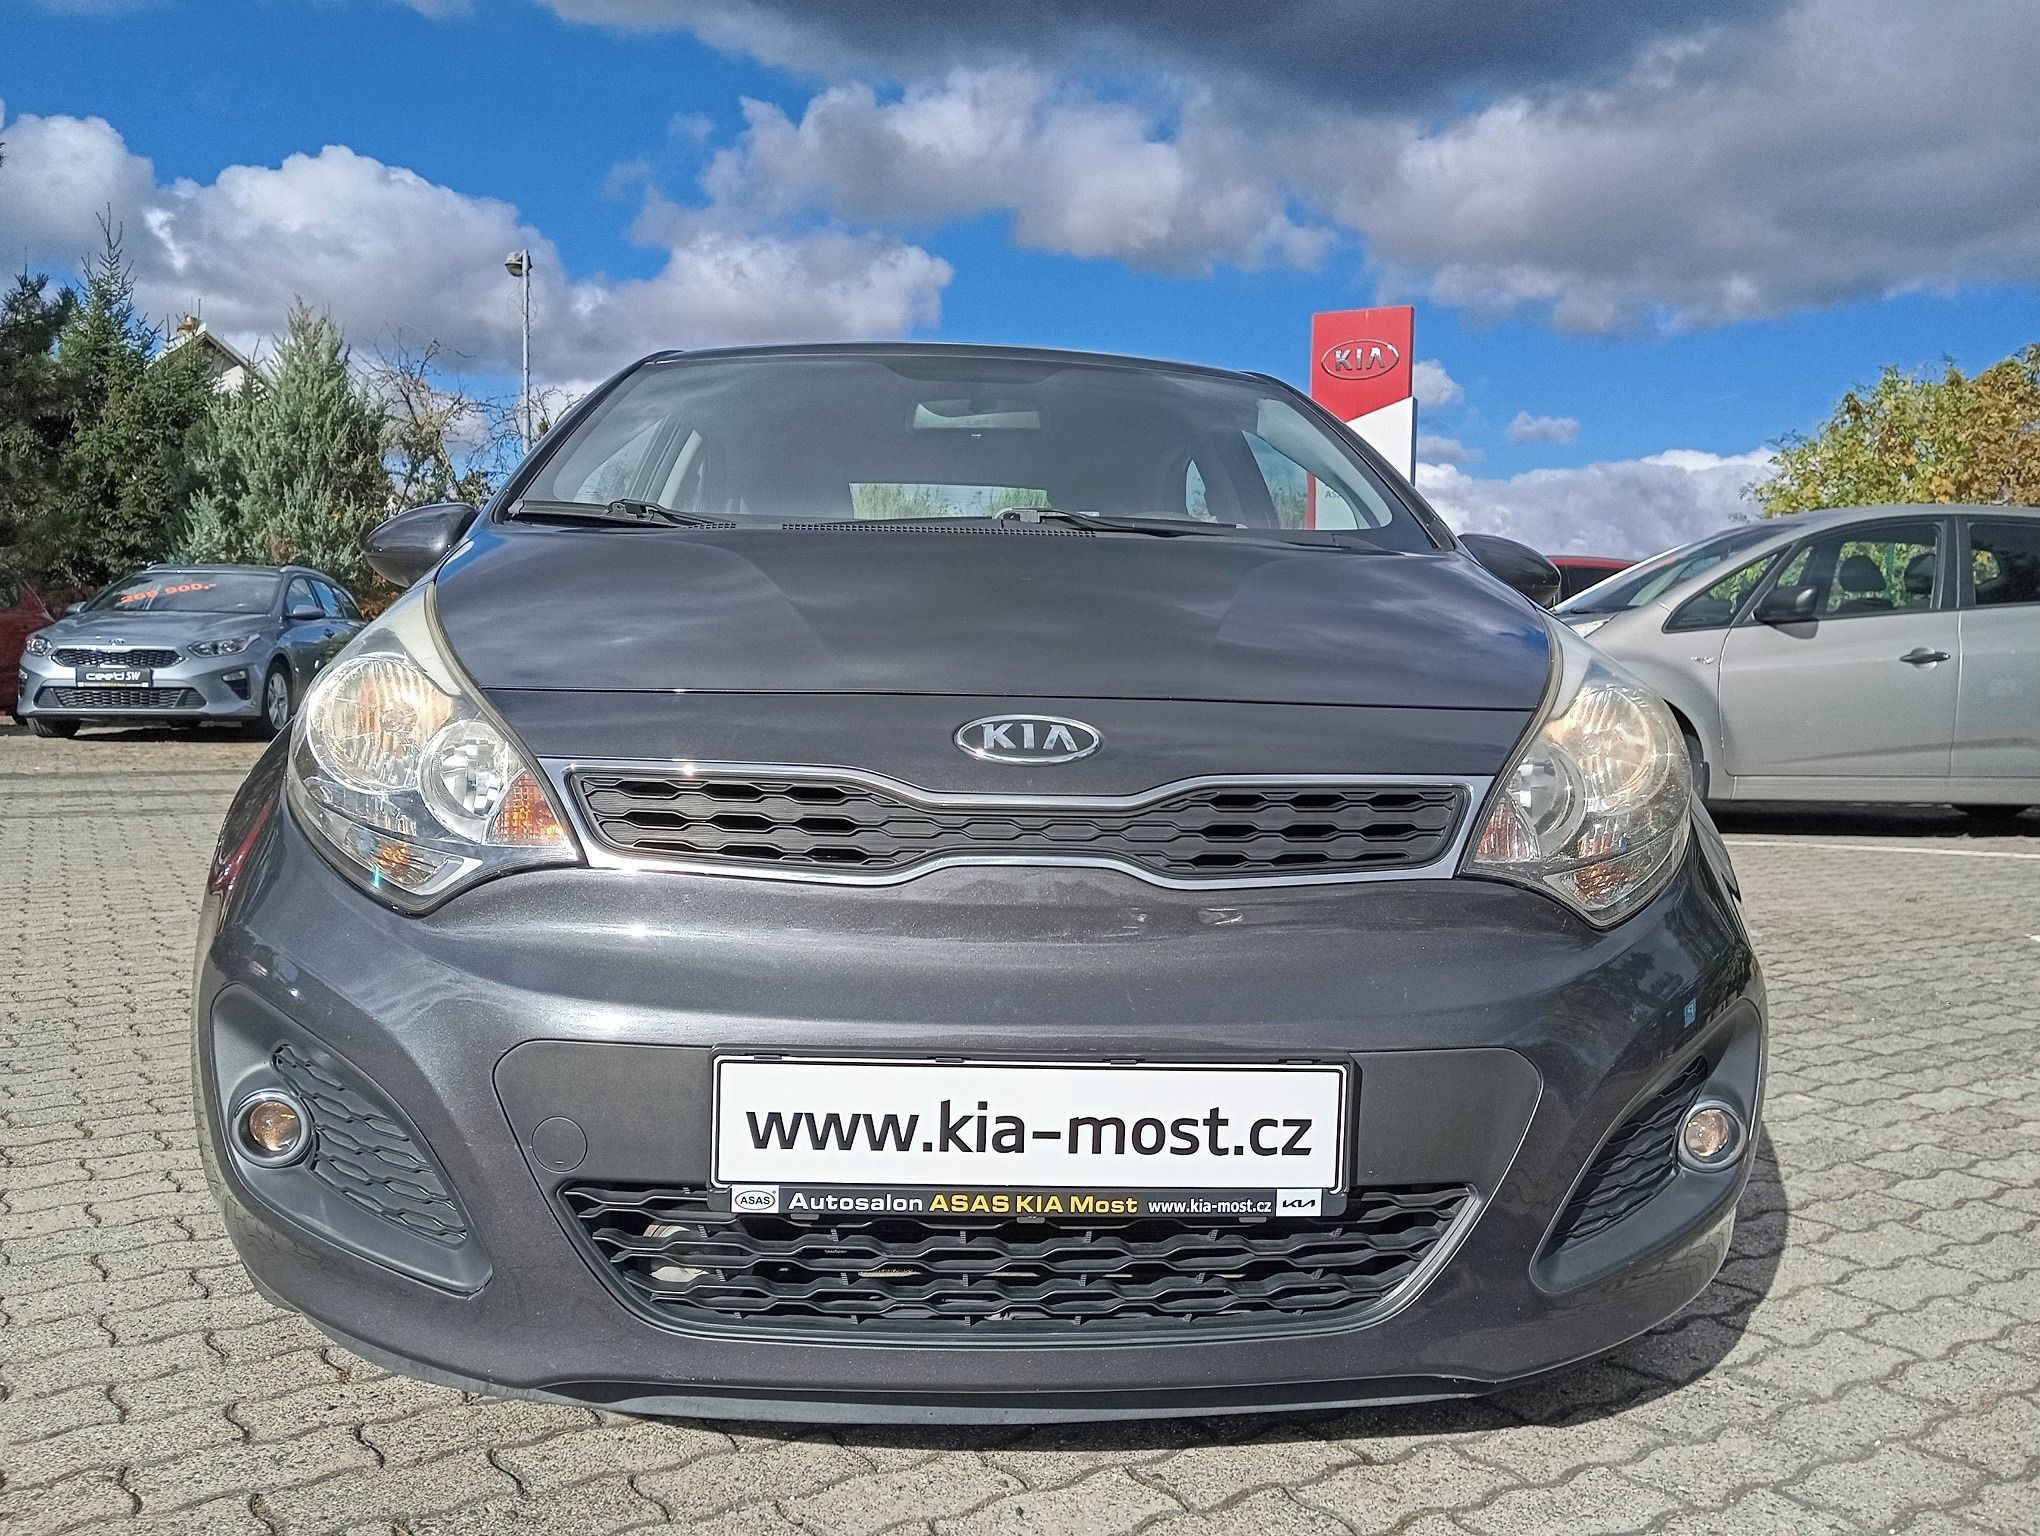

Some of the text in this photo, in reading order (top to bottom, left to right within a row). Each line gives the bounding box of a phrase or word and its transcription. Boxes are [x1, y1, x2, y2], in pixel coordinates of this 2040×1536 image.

[1335, 347, 1385, 371] KIA
[125, 671, 141, 681] SW
[981, 723, 1078, 751] KIA
[746, 1100, 1312, 1156] www.kia-most.cz
[740, 1196, 770, 1205] ASAS
[788, 1192, 1138, 1214] Autosalon ASAS KIA Most
[1148, 1198, 1272, 1214] www.kia-most.cz
